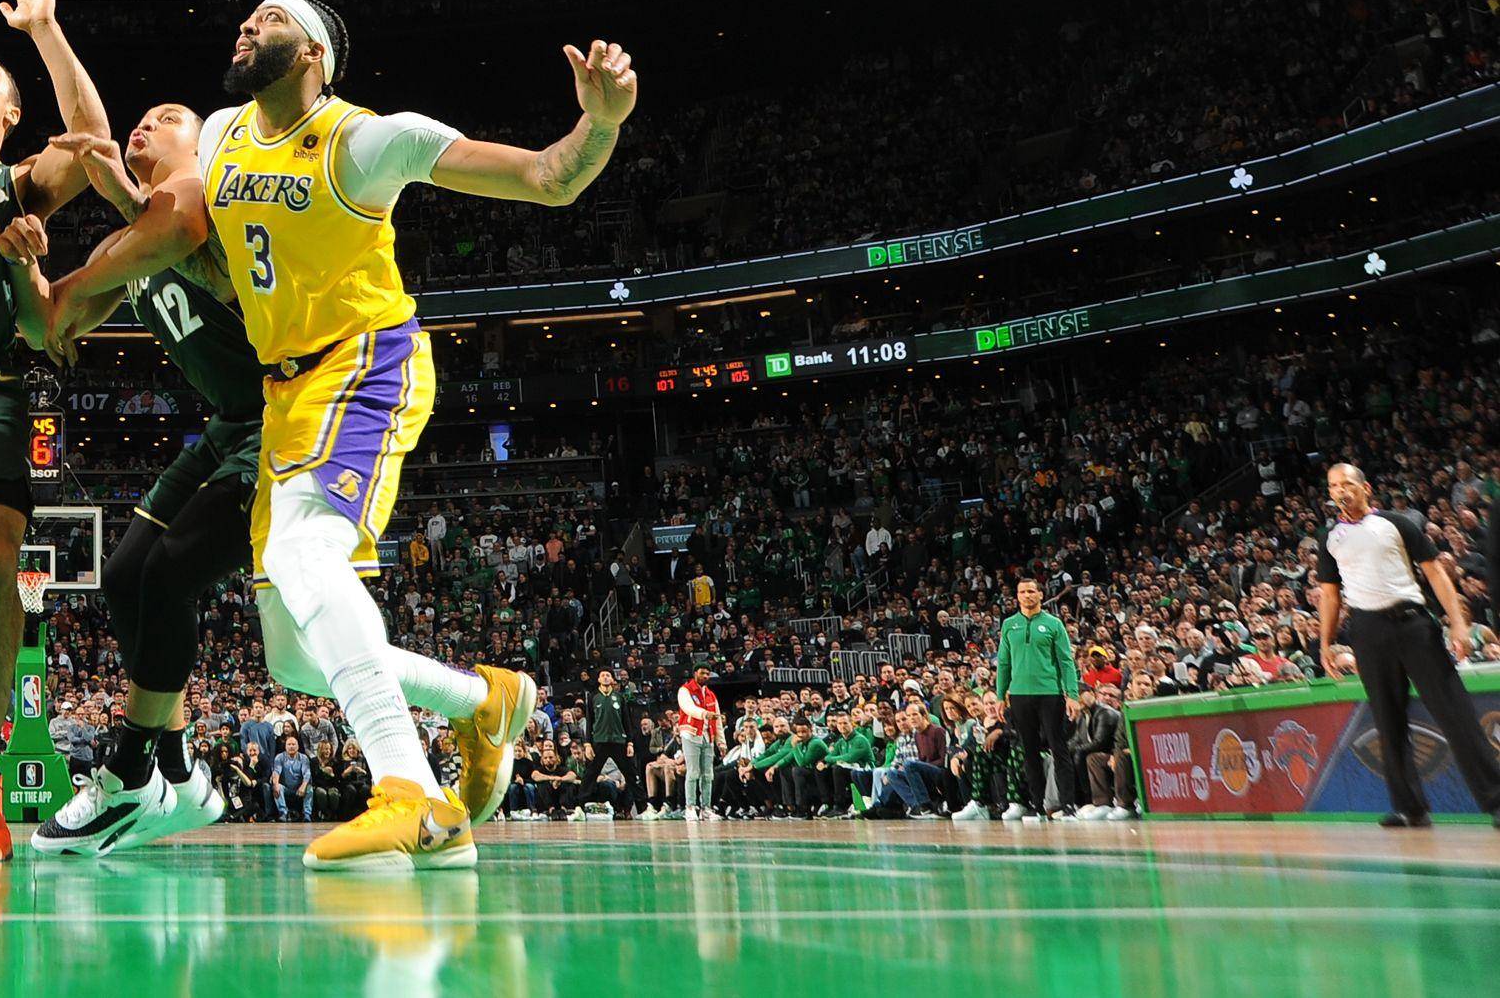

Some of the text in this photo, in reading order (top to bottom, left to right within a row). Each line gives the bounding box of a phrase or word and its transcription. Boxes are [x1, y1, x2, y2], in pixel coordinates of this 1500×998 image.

[293, 149, 320, 162] bibigo
[213, 164, 313, 213] LAKERS
[867, 229, 984, 268] DEFENSE
[244, 222, 277, 295] 3
[152, 282, 204, 343] 12
[975, 310, 1090, 352] DEFENSE
[794, 351, 833, 367] Bank
[846, 341, 907, 366] 11:08
[460, 384, 479, 392] AST
[493, 382, 511, 390] REB
[605, 377, 629, 392] 16
[657, 379, 675, 391] 107
[67, 393, 110, 410] 107
[466, 395, 477, 403] 16
[497, 393, 509, 401] 42
[1151, 732, 1193, 765] TUESDAY
[10, 791, 52, 803] GET THE APP
